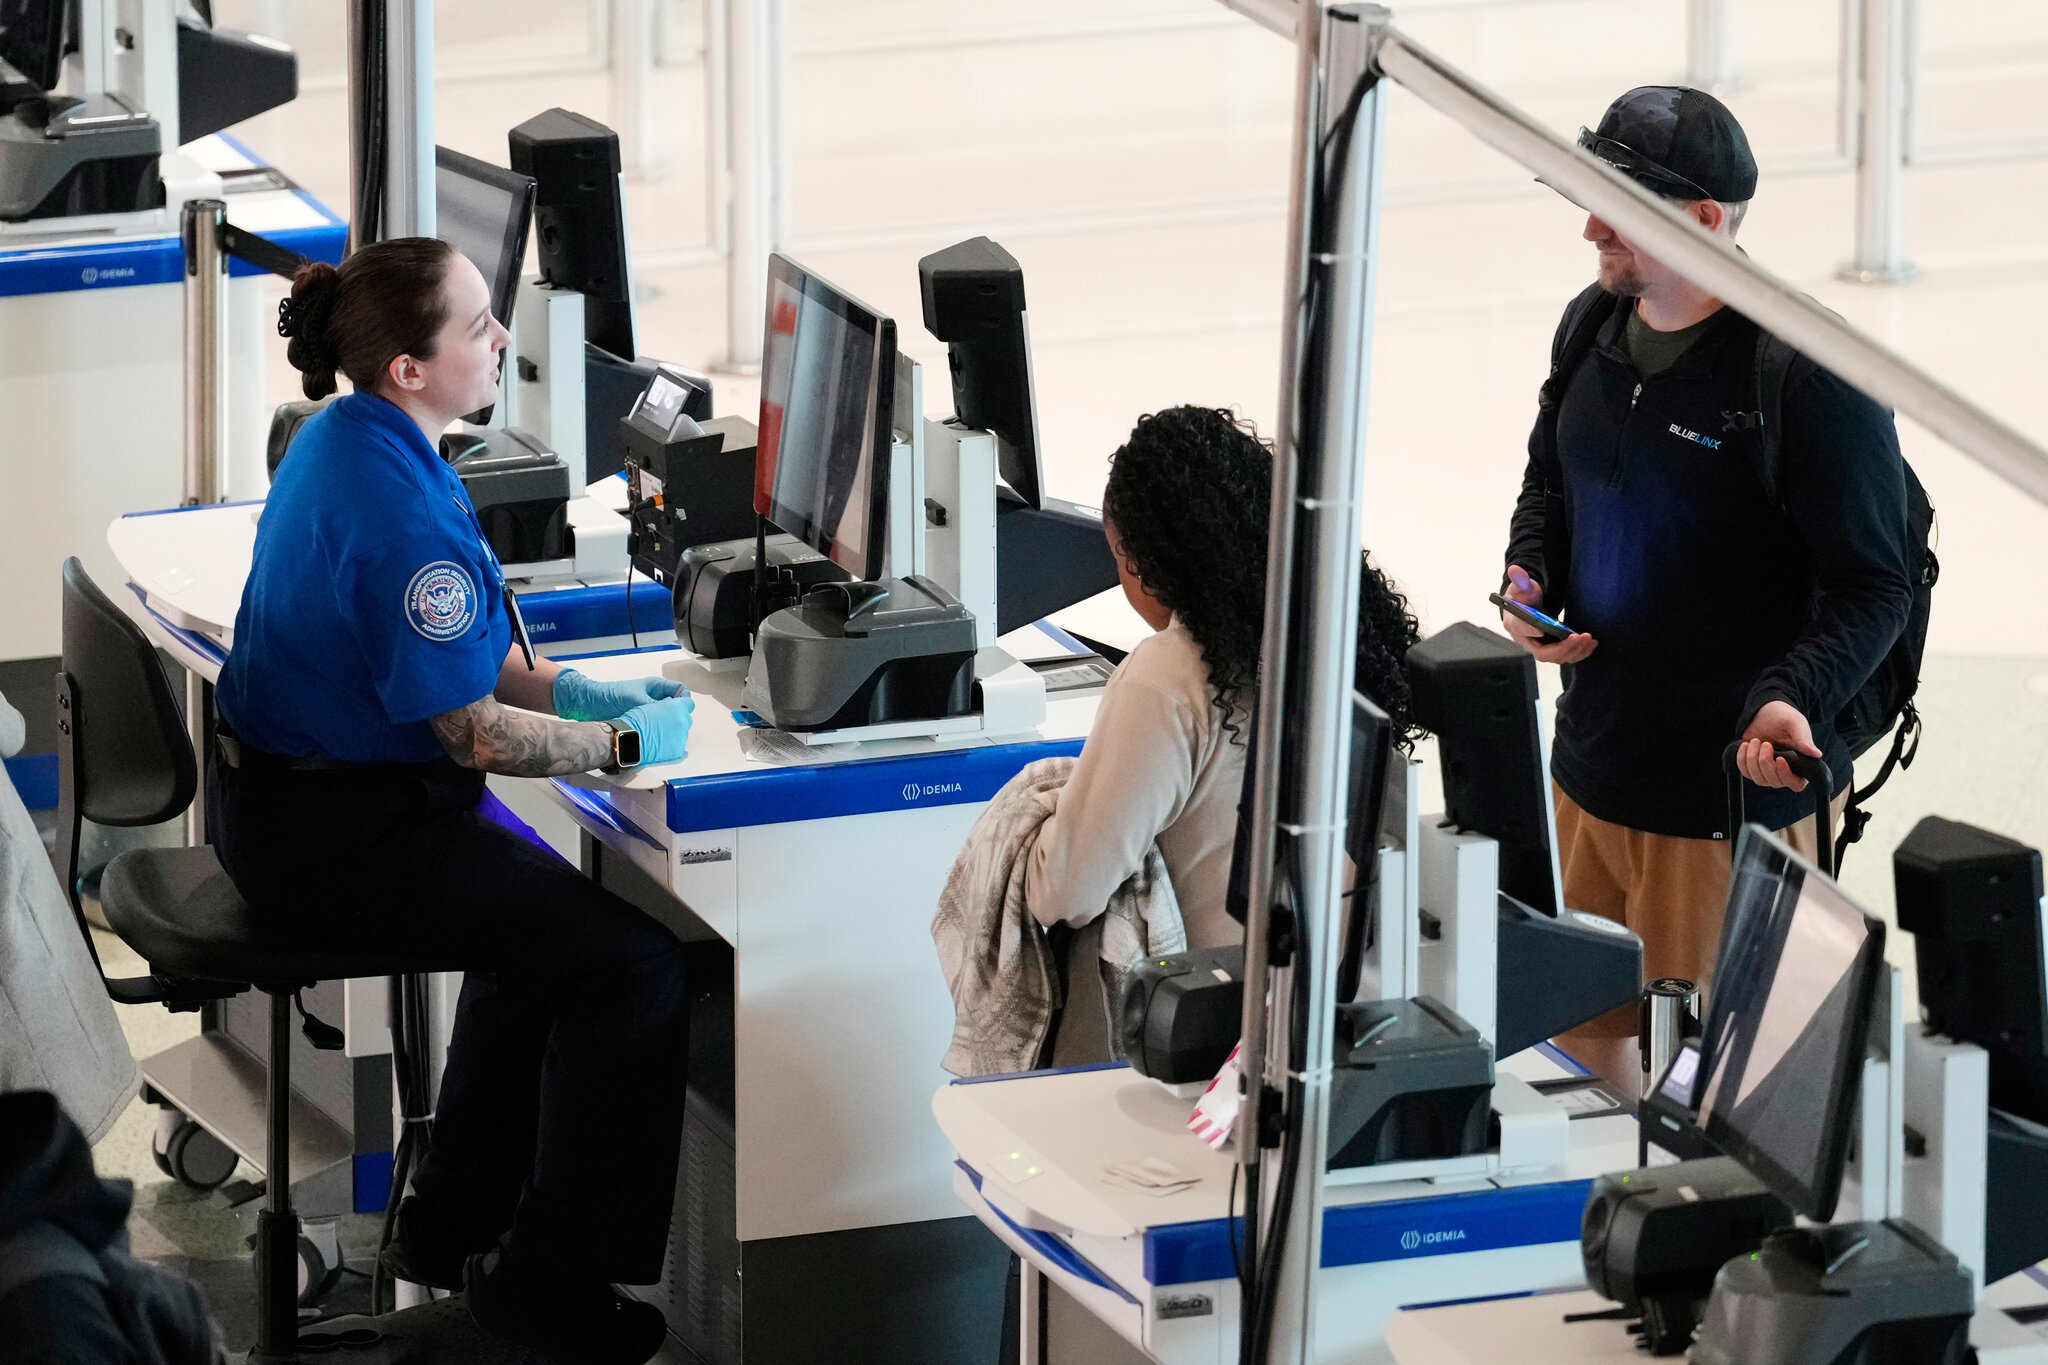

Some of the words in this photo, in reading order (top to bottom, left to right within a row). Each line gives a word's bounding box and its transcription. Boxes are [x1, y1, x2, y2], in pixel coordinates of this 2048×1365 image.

[1669, 423, 1722, 450] BLUELINX
[411, 568, 450, 611] TRANSPORTATION
[450, 569, 471, 596] SECURITY
[421, 611, 471, 635] ADMINISTRATION
[923, 783, 962, 795] IDEMIA
[1423, 1229, 1466, 1244] IDEMIA
